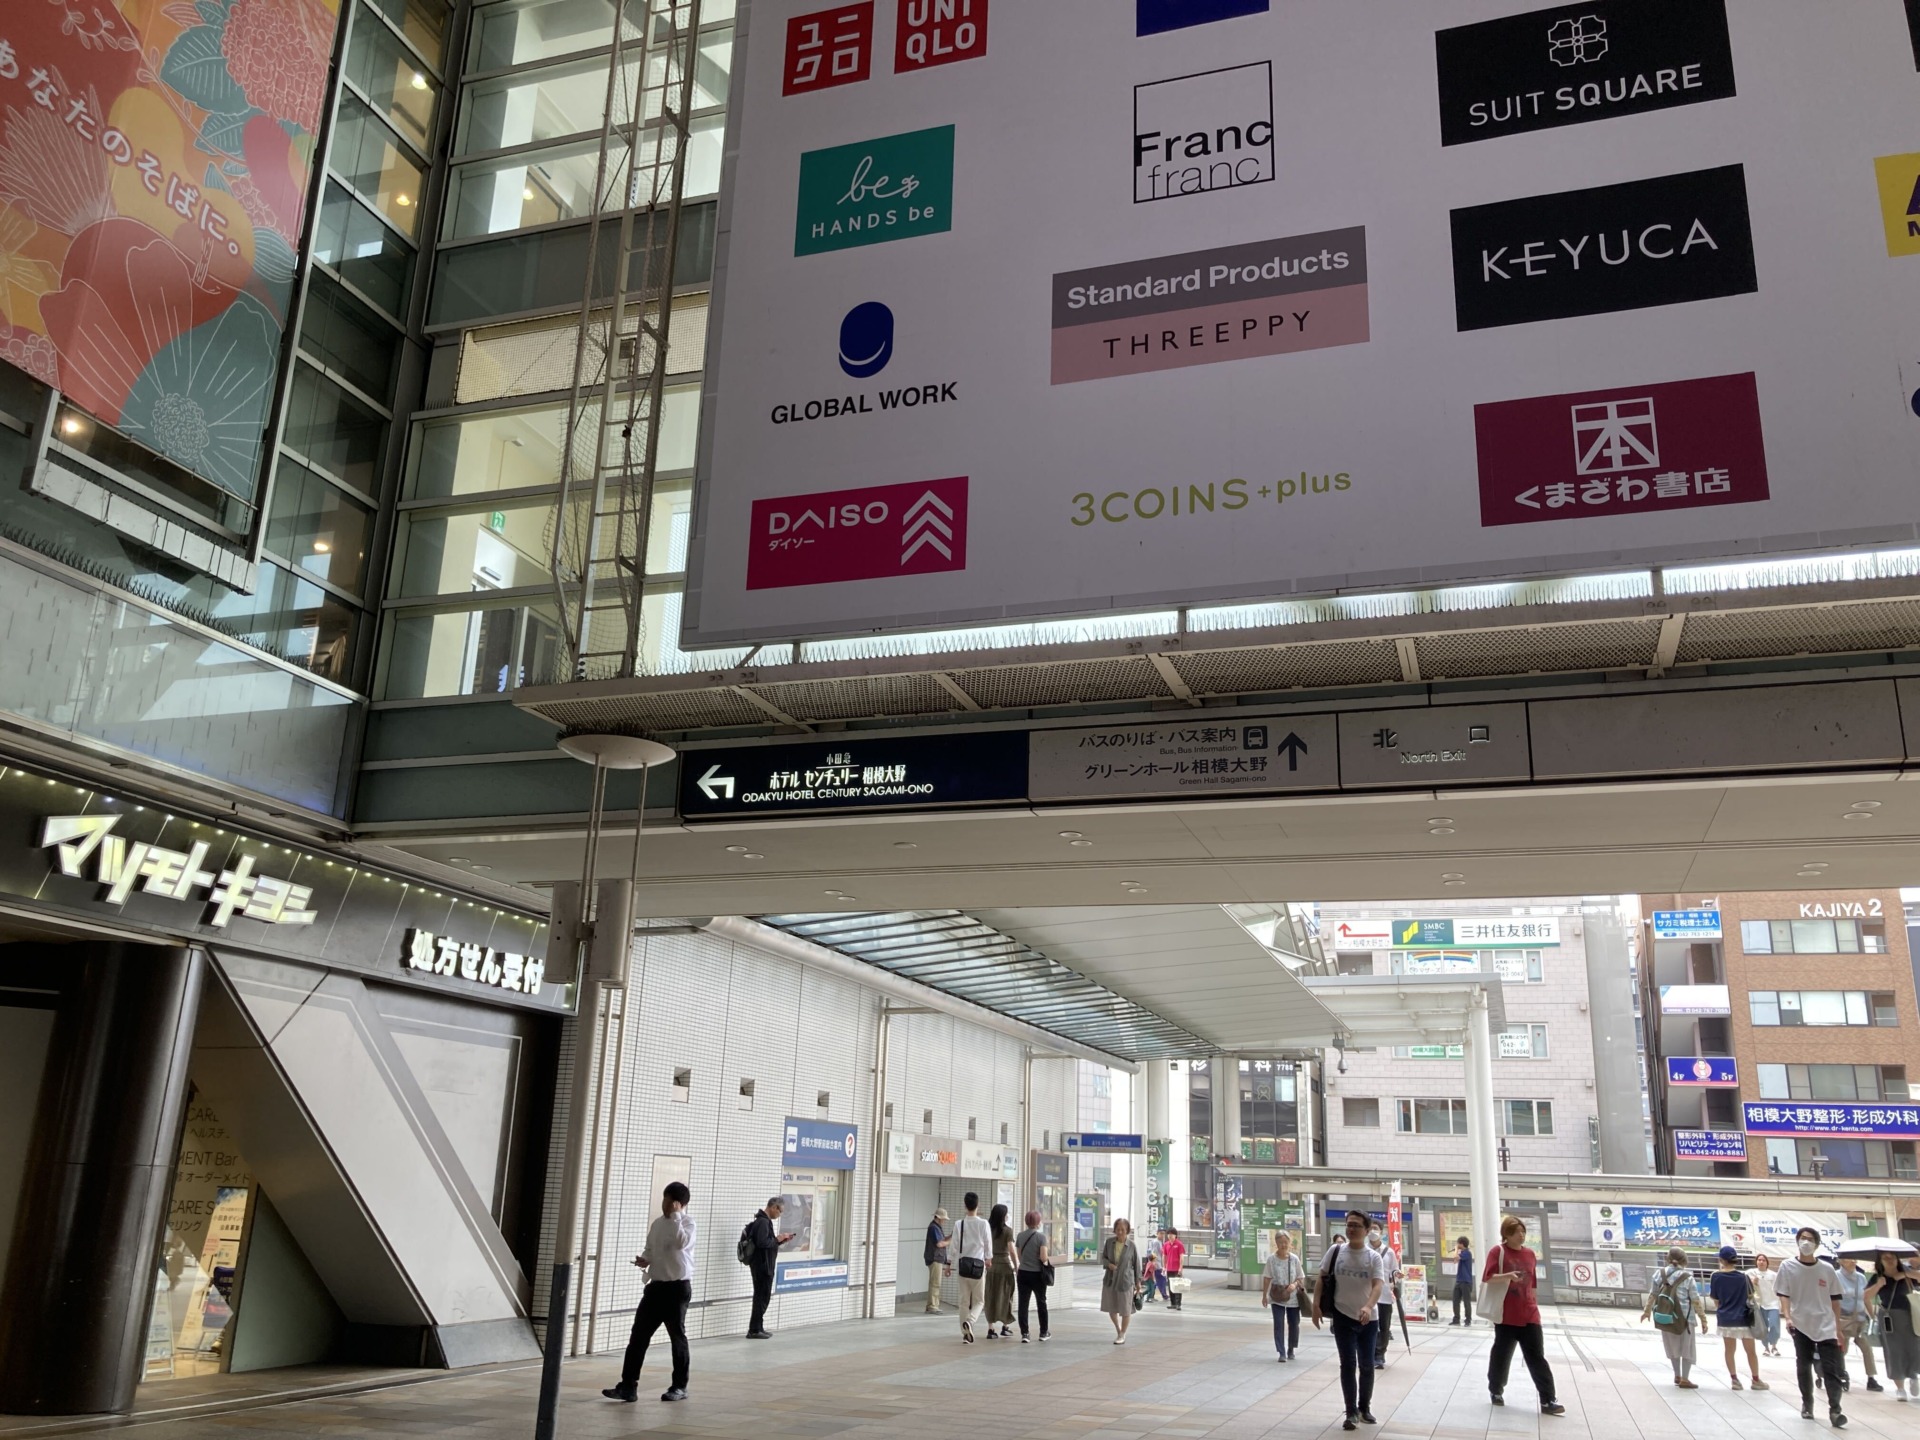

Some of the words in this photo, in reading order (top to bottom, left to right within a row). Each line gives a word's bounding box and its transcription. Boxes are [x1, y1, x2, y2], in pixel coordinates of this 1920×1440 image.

[908, 0, 971, 27] UNI
[797, 14, 860, 51] ユニ
[906, 22, 976, 63] QLO
[793, 46, 859, 84] クロ
[1468, 91, 1546, 126] SUIT
[1555, 63, 1703, 111] SQUARE
[1135, 118, 1273, 167] Franc
[1148, 156, 1261, 199] franc
[812, 209, 897, 239] HANDS
[908, 206, 935, 221] be
[1482, 218, 1719, 282] KEYUCA
[1066, 268, 1201, 310] Standard
[1208, 247, 1350, 288] Products
[1103, 310, 1311, 360] THREEPPY
[770, 393, 873, 425] GLOBAL
[878, 381, 958, 411] WORK
[1514, 467, 1732, 510] くまざわ書店
[768, 501, 889, 535] DAISO
[768, 536, 815, 551] ダイソー
[1373, 728, 1398, 749] 北
[1468, 725, 1490, 743] 口
[826, 752, 851, 765] 小田急
[1177, 746, 1193, 754] Bus
[1401, 751, 1438, 764] North
[1441, 750, 1467, 762] Exit
[770, 771, 800, 789] ホテル
[862, 764, 906, 784] 相模大野
[1084, 756, 1268, 779] グリーンホール相模大野
[1220, 774, 1267, 784] Sagami-ono
[742, 791, 784, 803] ODAKYU
[786, 789, 816, 800] HOTEL
[817, 787, 862, 798] CENTURY
[863, 783, 934, 796] SAGAMI-ONO
[42, 814, 318, 928] マツモトキヨシ
[1799, 902, 1866, 917] KAJIYA
[1868, 898, 1883, 917] 2
[1423, 922, 1445, 930] SMBC
[1460, 923, 1552, 939] 三井住友銀行
[409, 928, 545, 995] 処方せん受付
[1672, 1072, 1685, 1080] 4F
[1721, 1072, 1734, 1080] 5F
[1747, 1107, 1920, 1126] 相模大野整形・形成外科
[1679, 1140, 1743, 1149] リハビリテーション科
[215, 1152, 238, 1166] Bar
[205, 1200, 216, 1215] S
[1641, 1214, 1699, 1228] 相模原には
[1634, 1226, 1712, 1241] ギオンスがある
